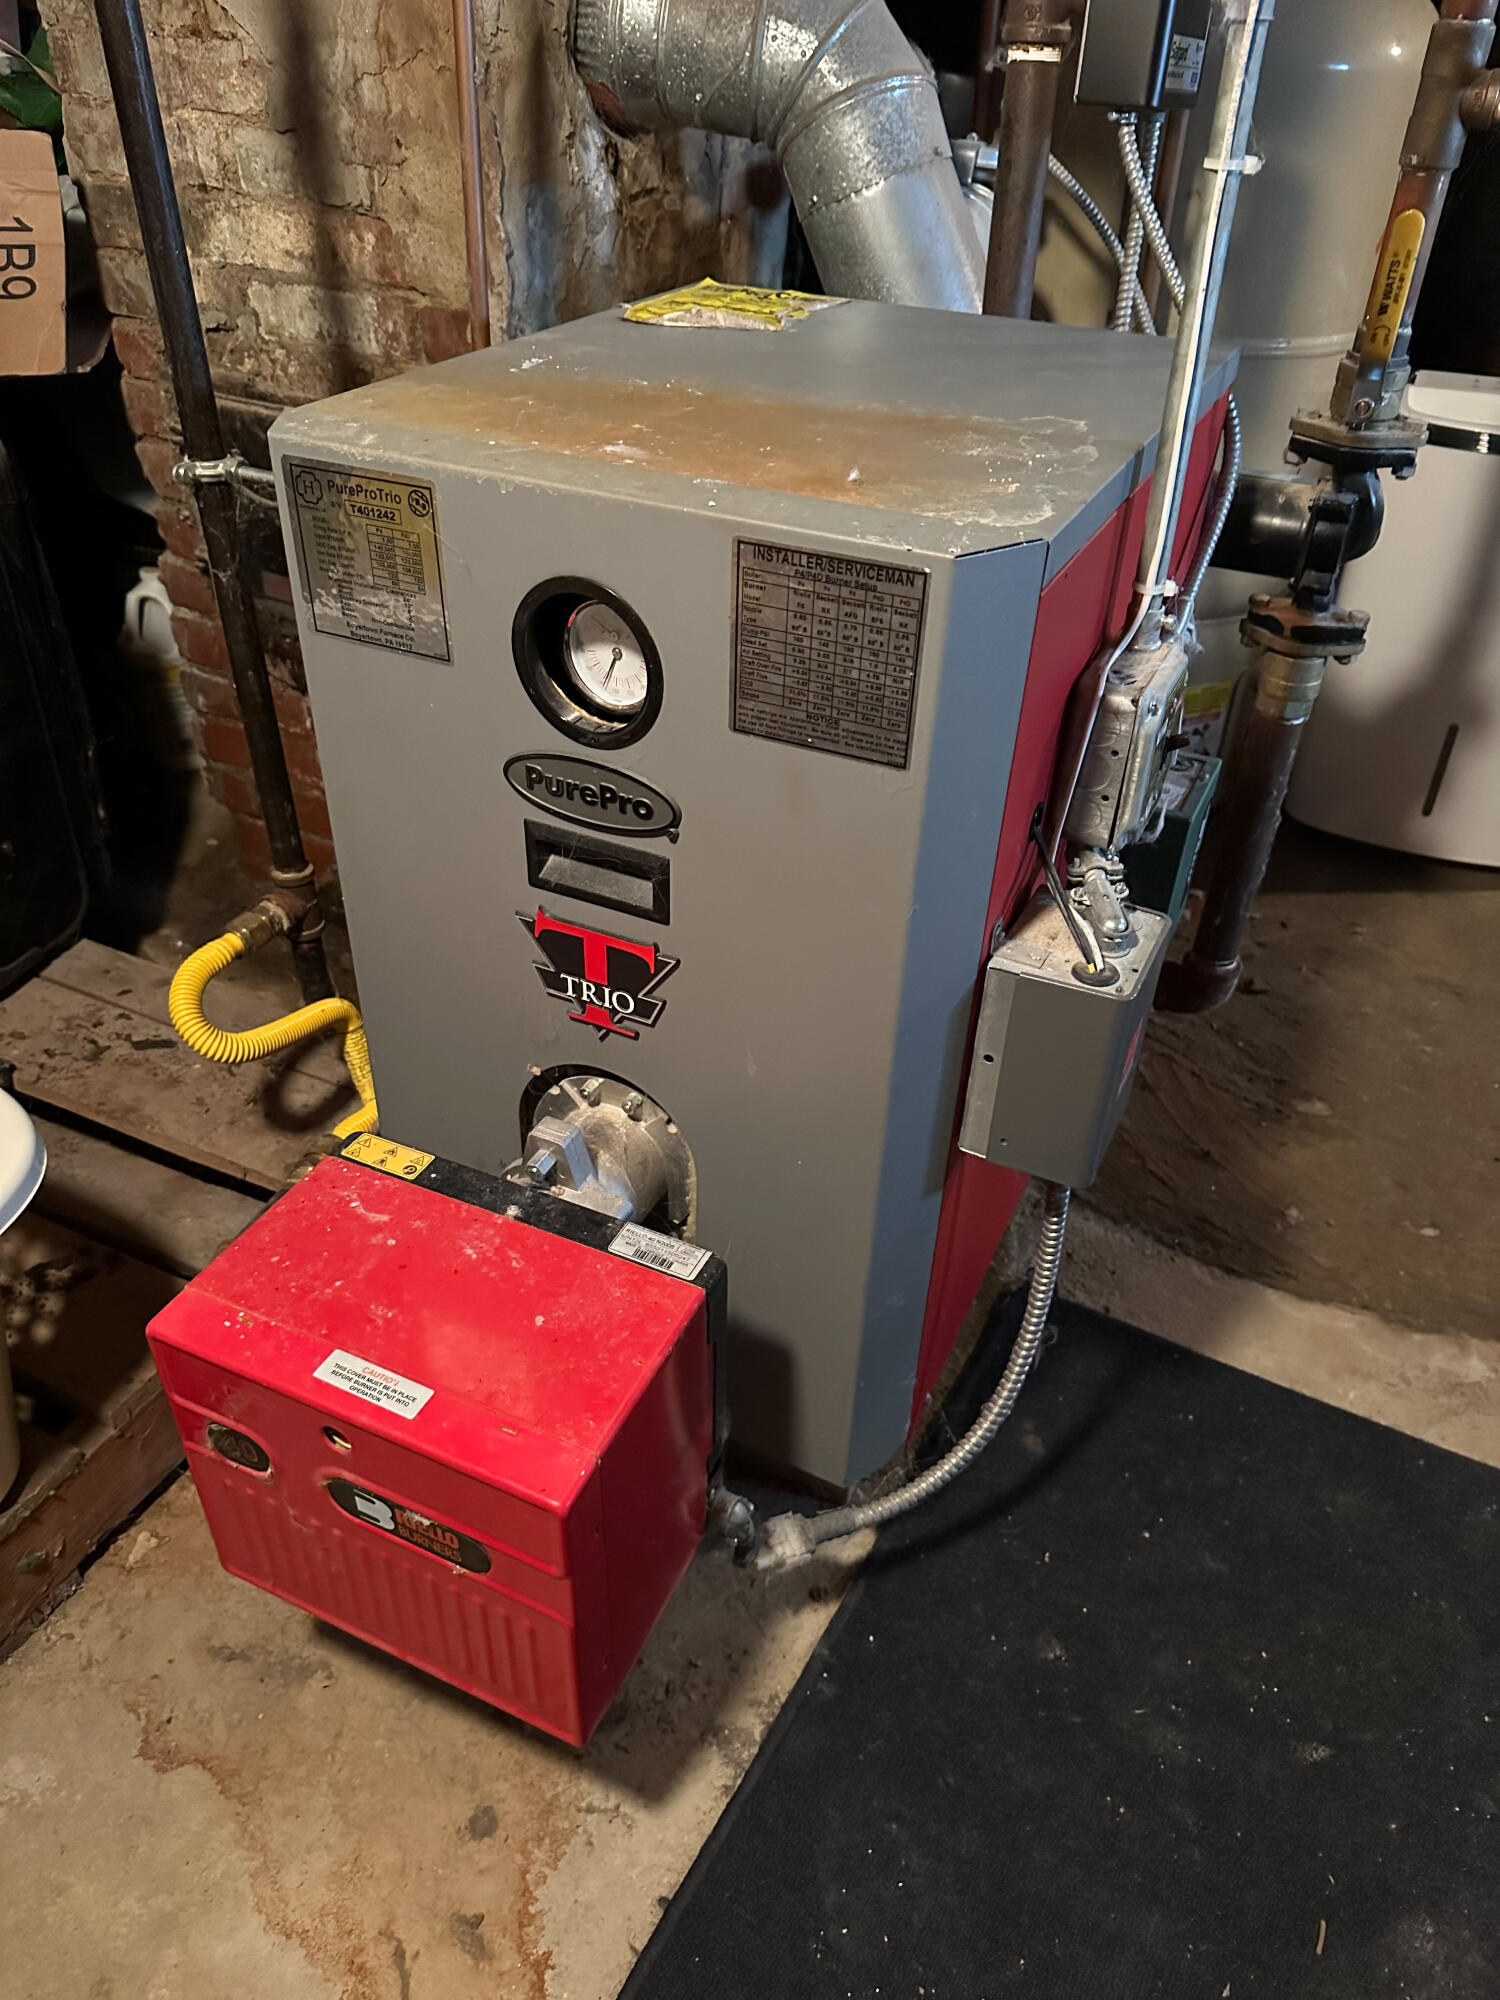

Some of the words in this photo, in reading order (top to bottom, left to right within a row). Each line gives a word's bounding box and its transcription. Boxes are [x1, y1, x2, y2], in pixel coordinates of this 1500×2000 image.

[1380, 258, 1400, 302] WATTS
[326, 479, 402, 505] PureProTrio
[349, 503, 396, 522] T401242
[753, 545, 916, 588] INSTALLER/SERVICEMAN
[743, 581, 766, 591] Burner
[794, 568, 822, 581] P4/P4D
[824, 573, 853, 587] Burner
[853, 579, 879, 593] Setup
[345, 620, 379, 635] Boyertown
[379, 628, 404, 640] Furnace
[805, 712, 840, 727] NOTICE
[525, 763, 655, 821] PurePro
[560, 973, 635, 1014] TRIO
[331, 1370, 353, 1382] BEFORE
[353, 1379, 377, 1393] BURNER
[383, 1392, 396, 1401] PUT
[395, 1398, 410, 1407] INTO
[334, 1363, 347, 1372] THIS
[347, 1368, 366, 1380] COVER
[367, 1377, 383, 1386] MUST
[398, 1390, 417, 1403] PLACE
[349, 1385, 382, 1403] OPERATION
